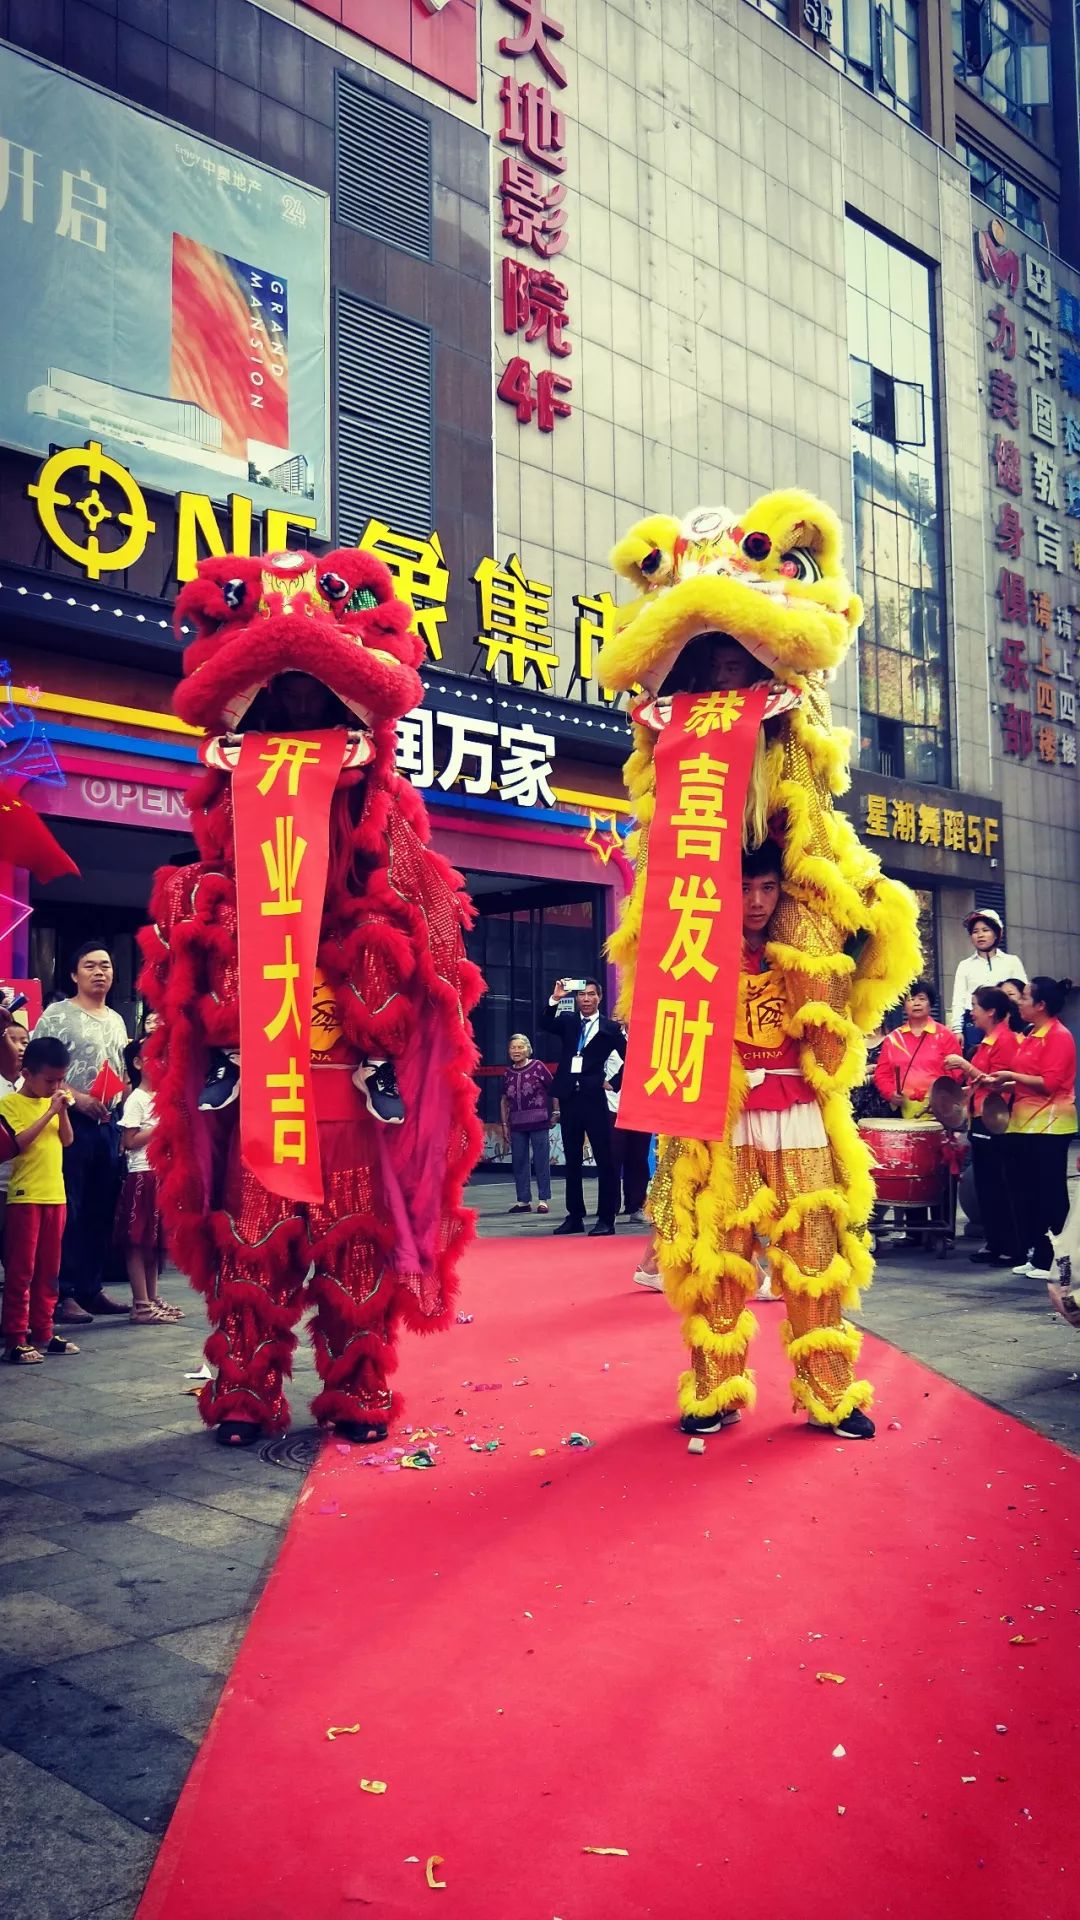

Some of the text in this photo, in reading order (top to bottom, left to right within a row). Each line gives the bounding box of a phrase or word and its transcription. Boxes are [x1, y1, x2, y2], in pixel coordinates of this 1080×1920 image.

[281, 195, 306, 225] 24
[250, 271, 264, 409] MANSION
[270, 280, 284, 377] GRAND
[256, 737, 321, 1165] 开业大吉
[644, 691, 745, 1103] 恭喜发财
[743, 1051, 783, 1060] CHINA
